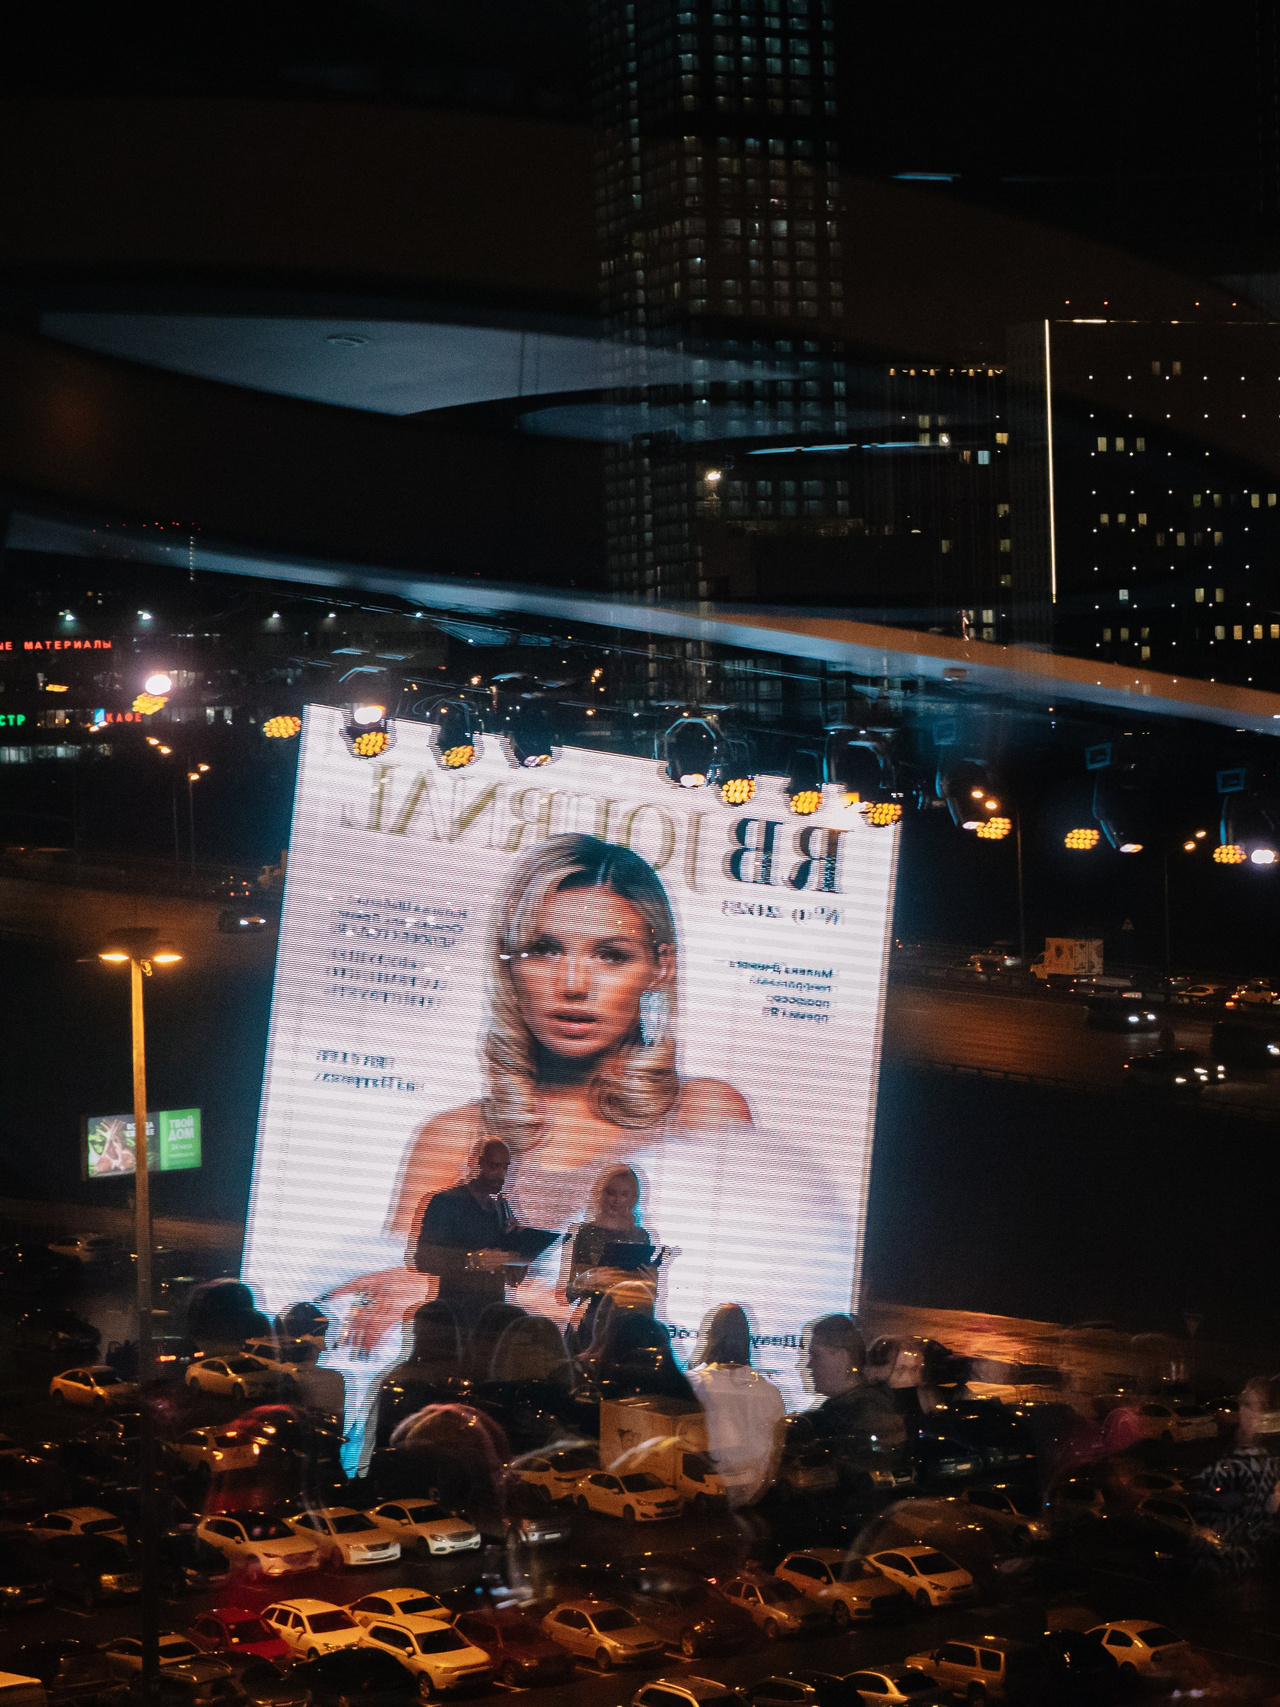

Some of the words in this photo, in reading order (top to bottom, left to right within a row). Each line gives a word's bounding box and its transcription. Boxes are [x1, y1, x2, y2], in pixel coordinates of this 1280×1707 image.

[23, 640, 112, 650] МАТЕРИАЛЫ
[105, 712, 142, 723] КАФЕ
[169, 1115, 194, 1128] ТВОЙ
[168, 1128, 194, 1141] ДОМ
